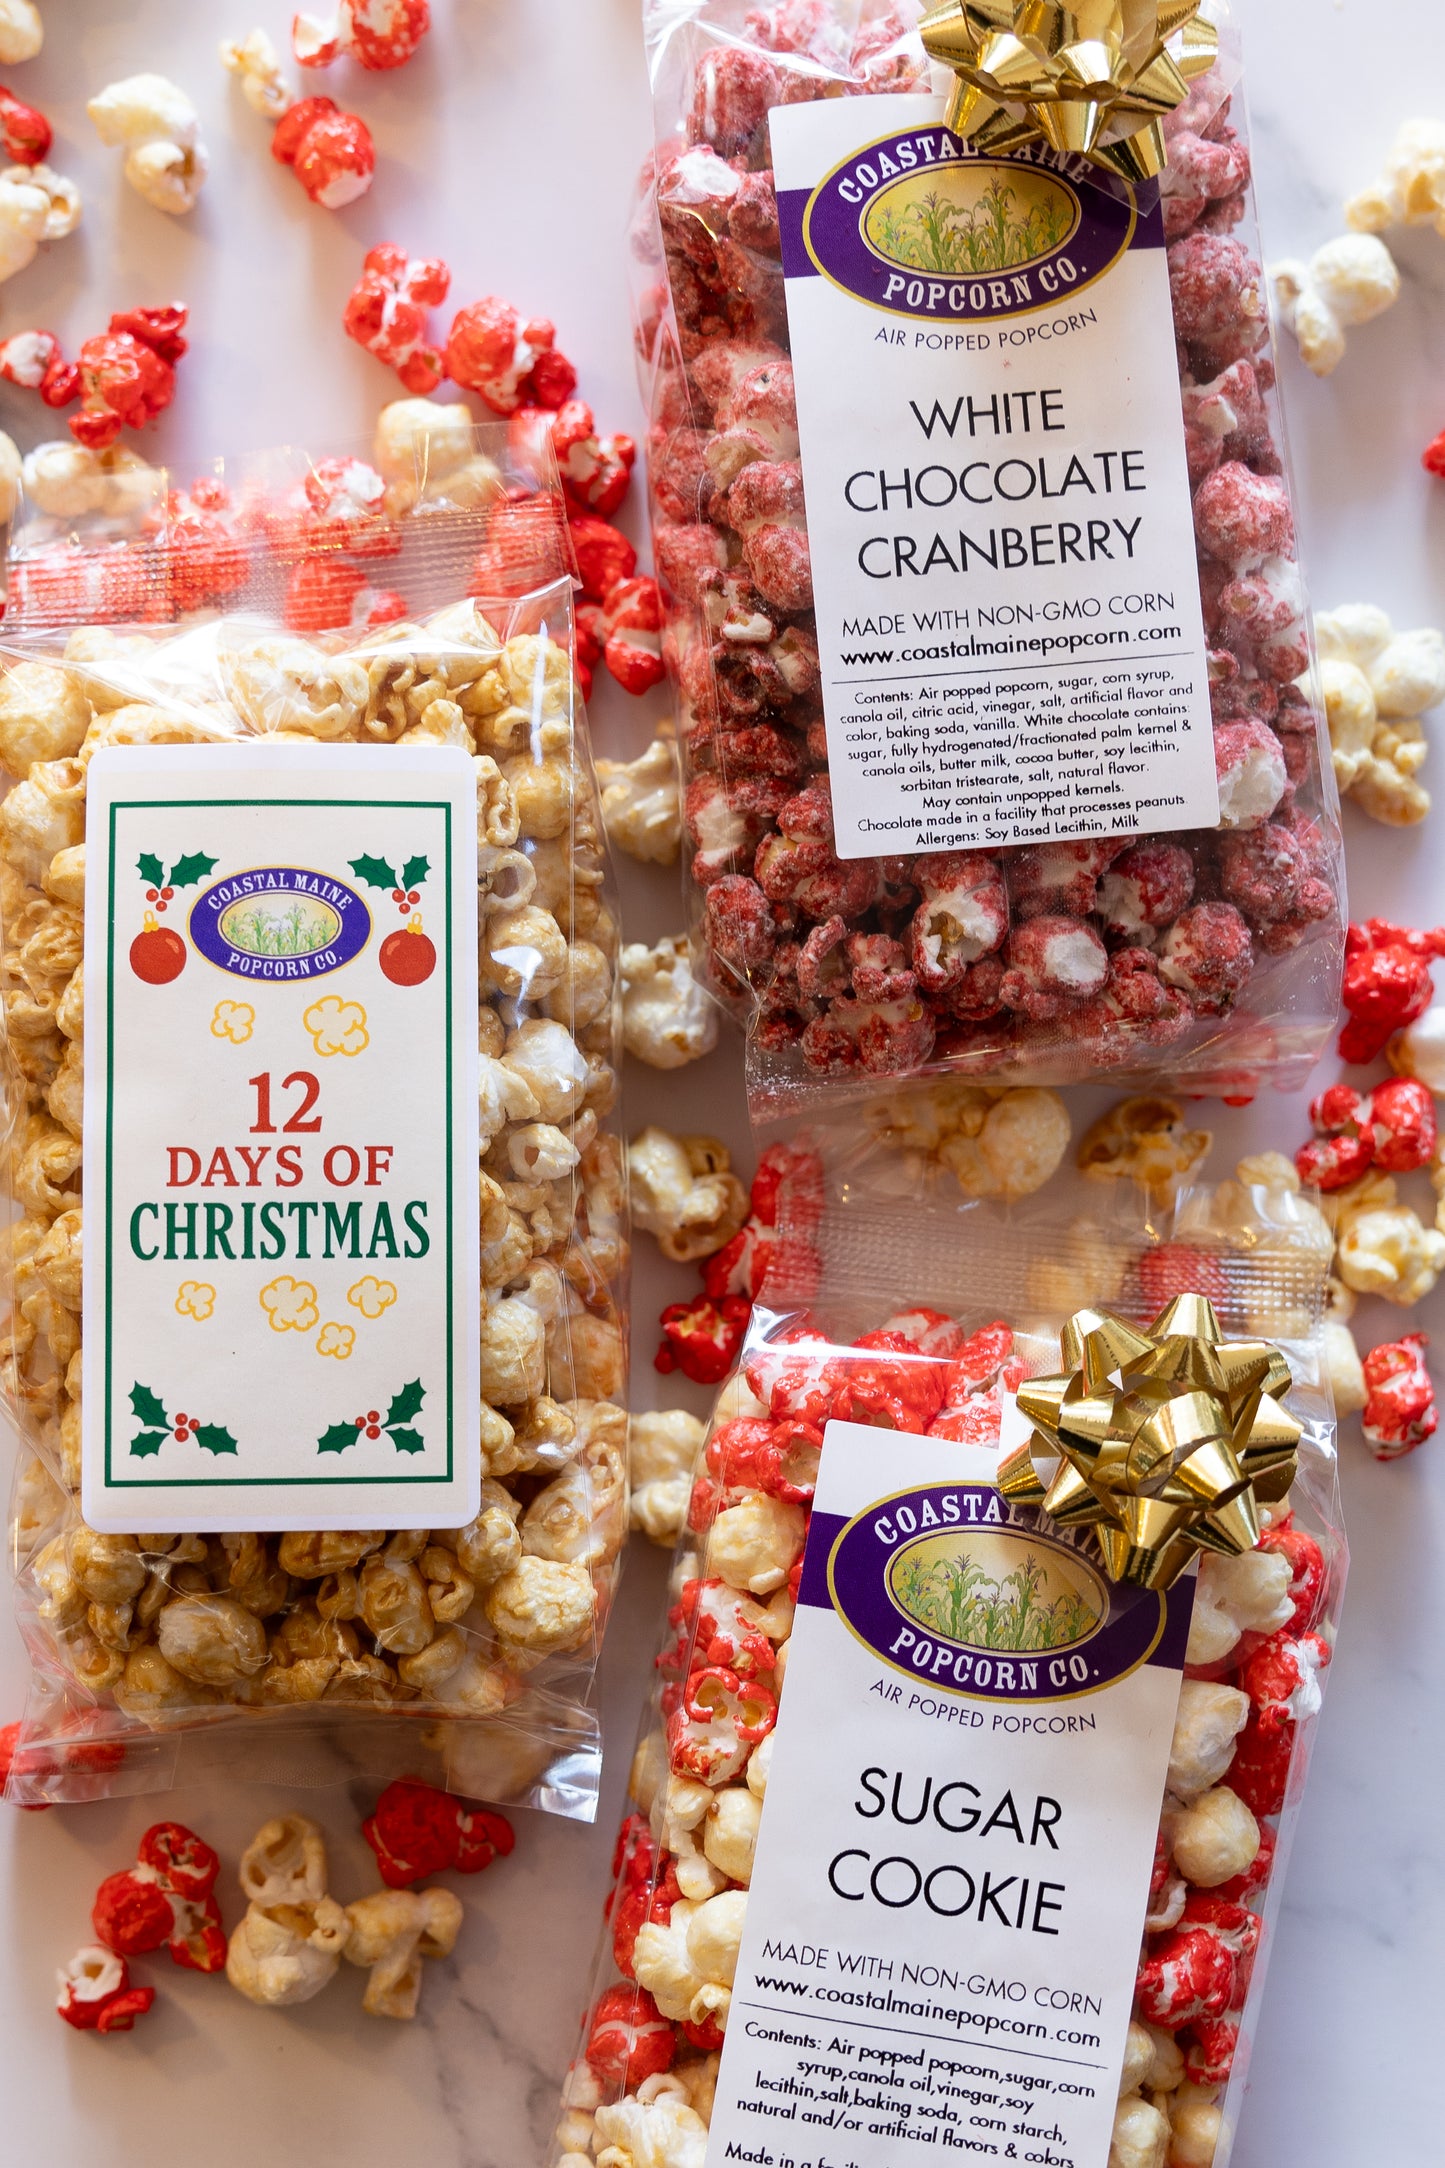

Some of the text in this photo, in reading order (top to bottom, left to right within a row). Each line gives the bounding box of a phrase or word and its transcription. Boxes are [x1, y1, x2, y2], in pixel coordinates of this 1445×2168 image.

[838, 133, 1094, 203] COASTAL AINE
[882, 256, 1088, 312] POPCORN CO.
[874, 308, 1098, 351] AIR POPPED POPCORN
[908, 388, 1066, 440] WHITE
[844, 449, 1147, 512] CHOCOLATE
[857, 516, 1143, 579] CRANBERRY
[842, 591, 1175, 638] MADE WITH NON-GMO CORN
[839, 626, 1181, 666] www.coastalmainepopcorn.com
[839, 681, 1193, 724] canola oil, citric acid, vinegar, salt, artificial flavor and
[854, 670, 1174, 705] Contents: Air popped popcorn, sugar, corn syrup,
[845, 702, 1191, 742] color, baking soda, vanilla. White chocolate contains:
[847, 719, 1191, 763] sugar, fully hydrogenated/fractionated palm kernel &
[862, 739, 1179, 777] canola oils, butter milk, cocoa butter, soy lecithin,
[900, 761, 1149, 792] sorbitan tristearate, salt, natural flavor.
[857, 815, 923, 832] Chocolate
[926, 811, 962, 827] made
[965, 811, 978, 823] in
[982, 813, 991, 822] a
[994, 805, 1037, 822] facility
[1041, 803, 1066, 817] that
[1069, 800, 1131, 818] processes
[922, 779, 1124, 811] May contain unpopped kernels.
[915, 813, 1139, 846] Allergens: Soy Based Lecithin, Milk
[207, 872, 353, 911] COASTAL MAINE
[227, 950, 343, 977] POPCORN CO.
[248, 1071, 323, 1134] 12
[166, 1145, 394, 1188] DAYS OF
[129, 1200, 430, 1261] CHRISTMAS
[874, 1494, 1024, 1545] COASTAL
[889, 1627, 1101, 1691] POPCORN CO.
[870, 1679, 1097, 1733] AIR POPPED POPCORN
[854, 1766, 1062, 1850] SUGAR
[827, 1848, 1066, 1936] COOKIE
[761, 1938, 1102, 2016] MADE WITH NON-GMO CORN
[754, 1975, 1100, 2048] www.coastalmainepopcorn.com
[744, 2020, 1095, 2098] Contents: Air popped popcorn,sugar,corn
[755, 2070, 1067, 2146] lecithin,salt,baking soda, corn starch,
[796, 2061, 1035, 2115] syrup,canola oil,vinegar,soy
[725, 2141, 774, 2166] Made
[736, 2099, 1074, 2168] natural and/or artificial flavors & colors
